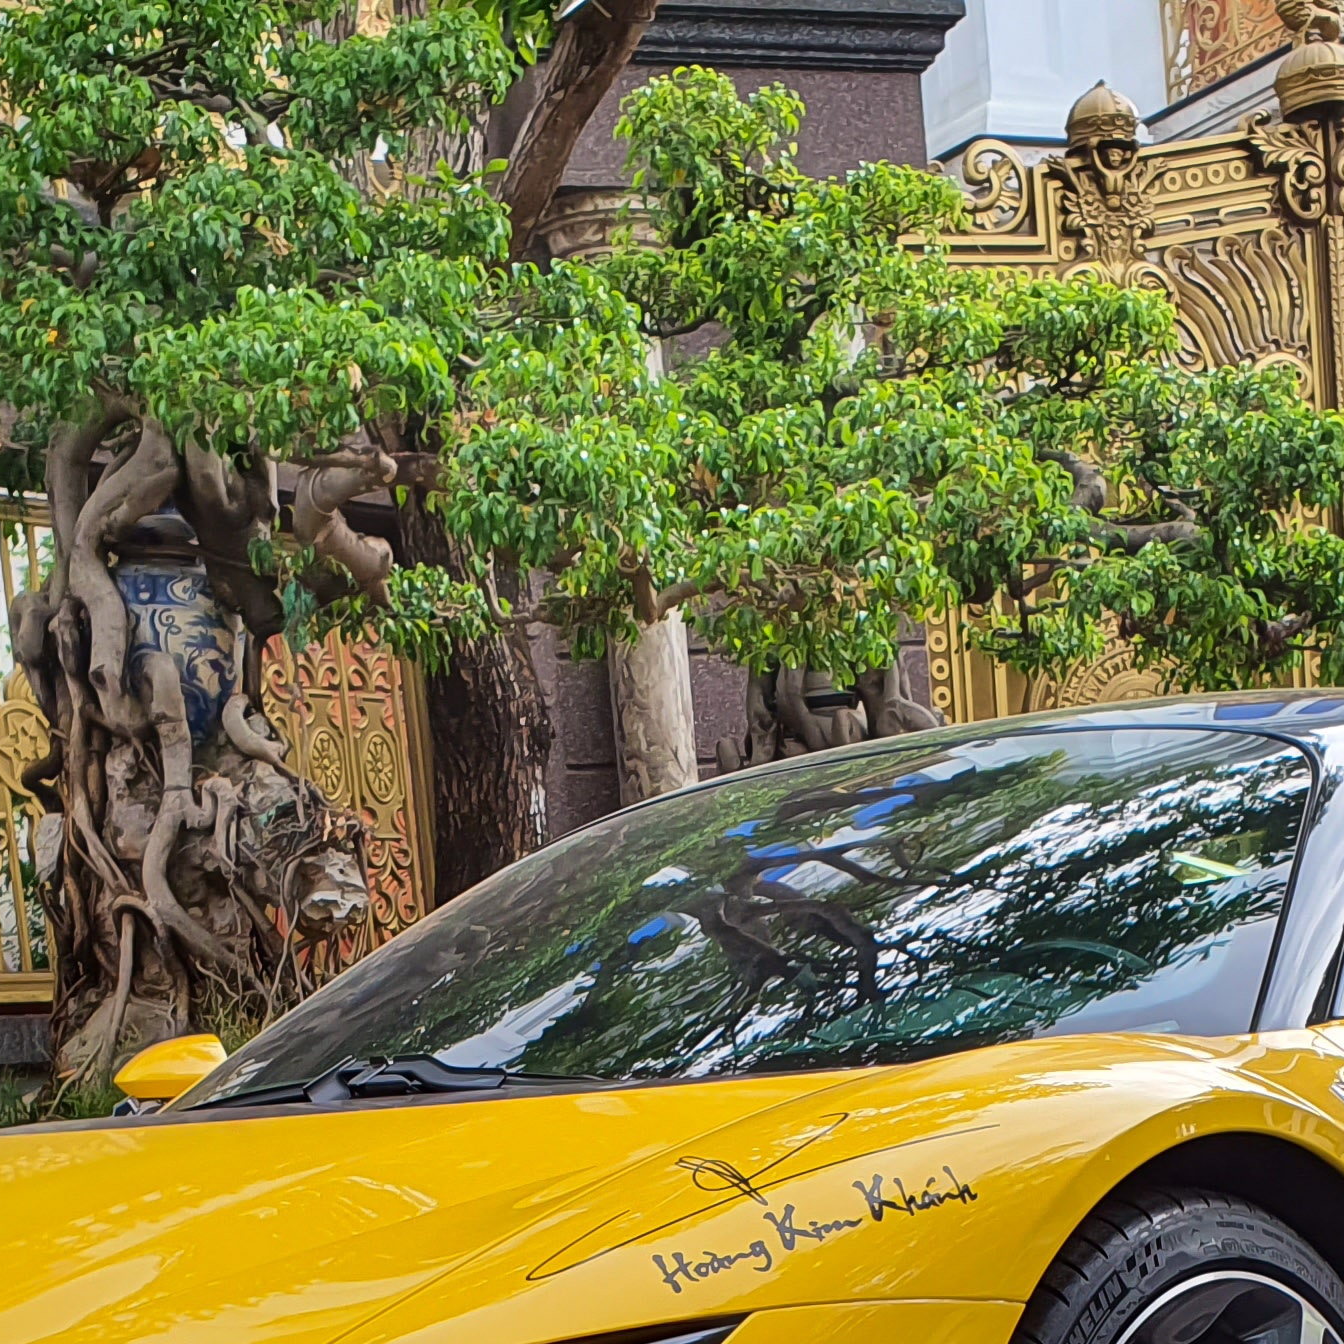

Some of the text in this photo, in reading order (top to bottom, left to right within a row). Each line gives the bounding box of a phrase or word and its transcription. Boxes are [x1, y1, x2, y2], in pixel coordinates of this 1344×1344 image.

[652, 1165, 978, 1294] Hoàng Kim Khánh
